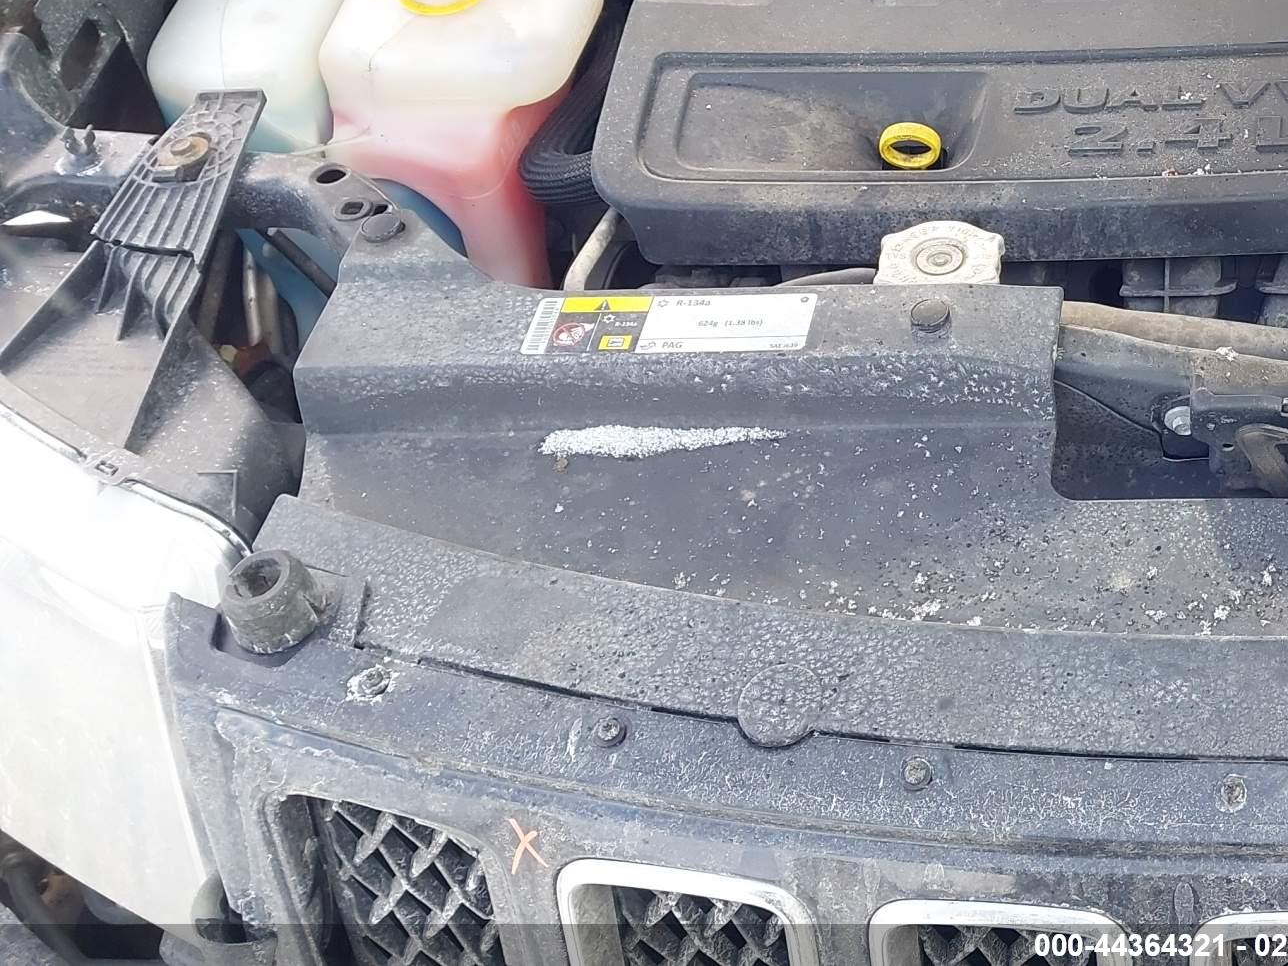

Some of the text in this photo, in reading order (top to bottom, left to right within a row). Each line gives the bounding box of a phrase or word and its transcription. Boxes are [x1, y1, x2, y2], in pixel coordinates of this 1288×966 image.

[1014, 85, 1206, 114] DUAL
[675, 299, 712, 307] R-134a
[661, 341, 684, 349] PAG
